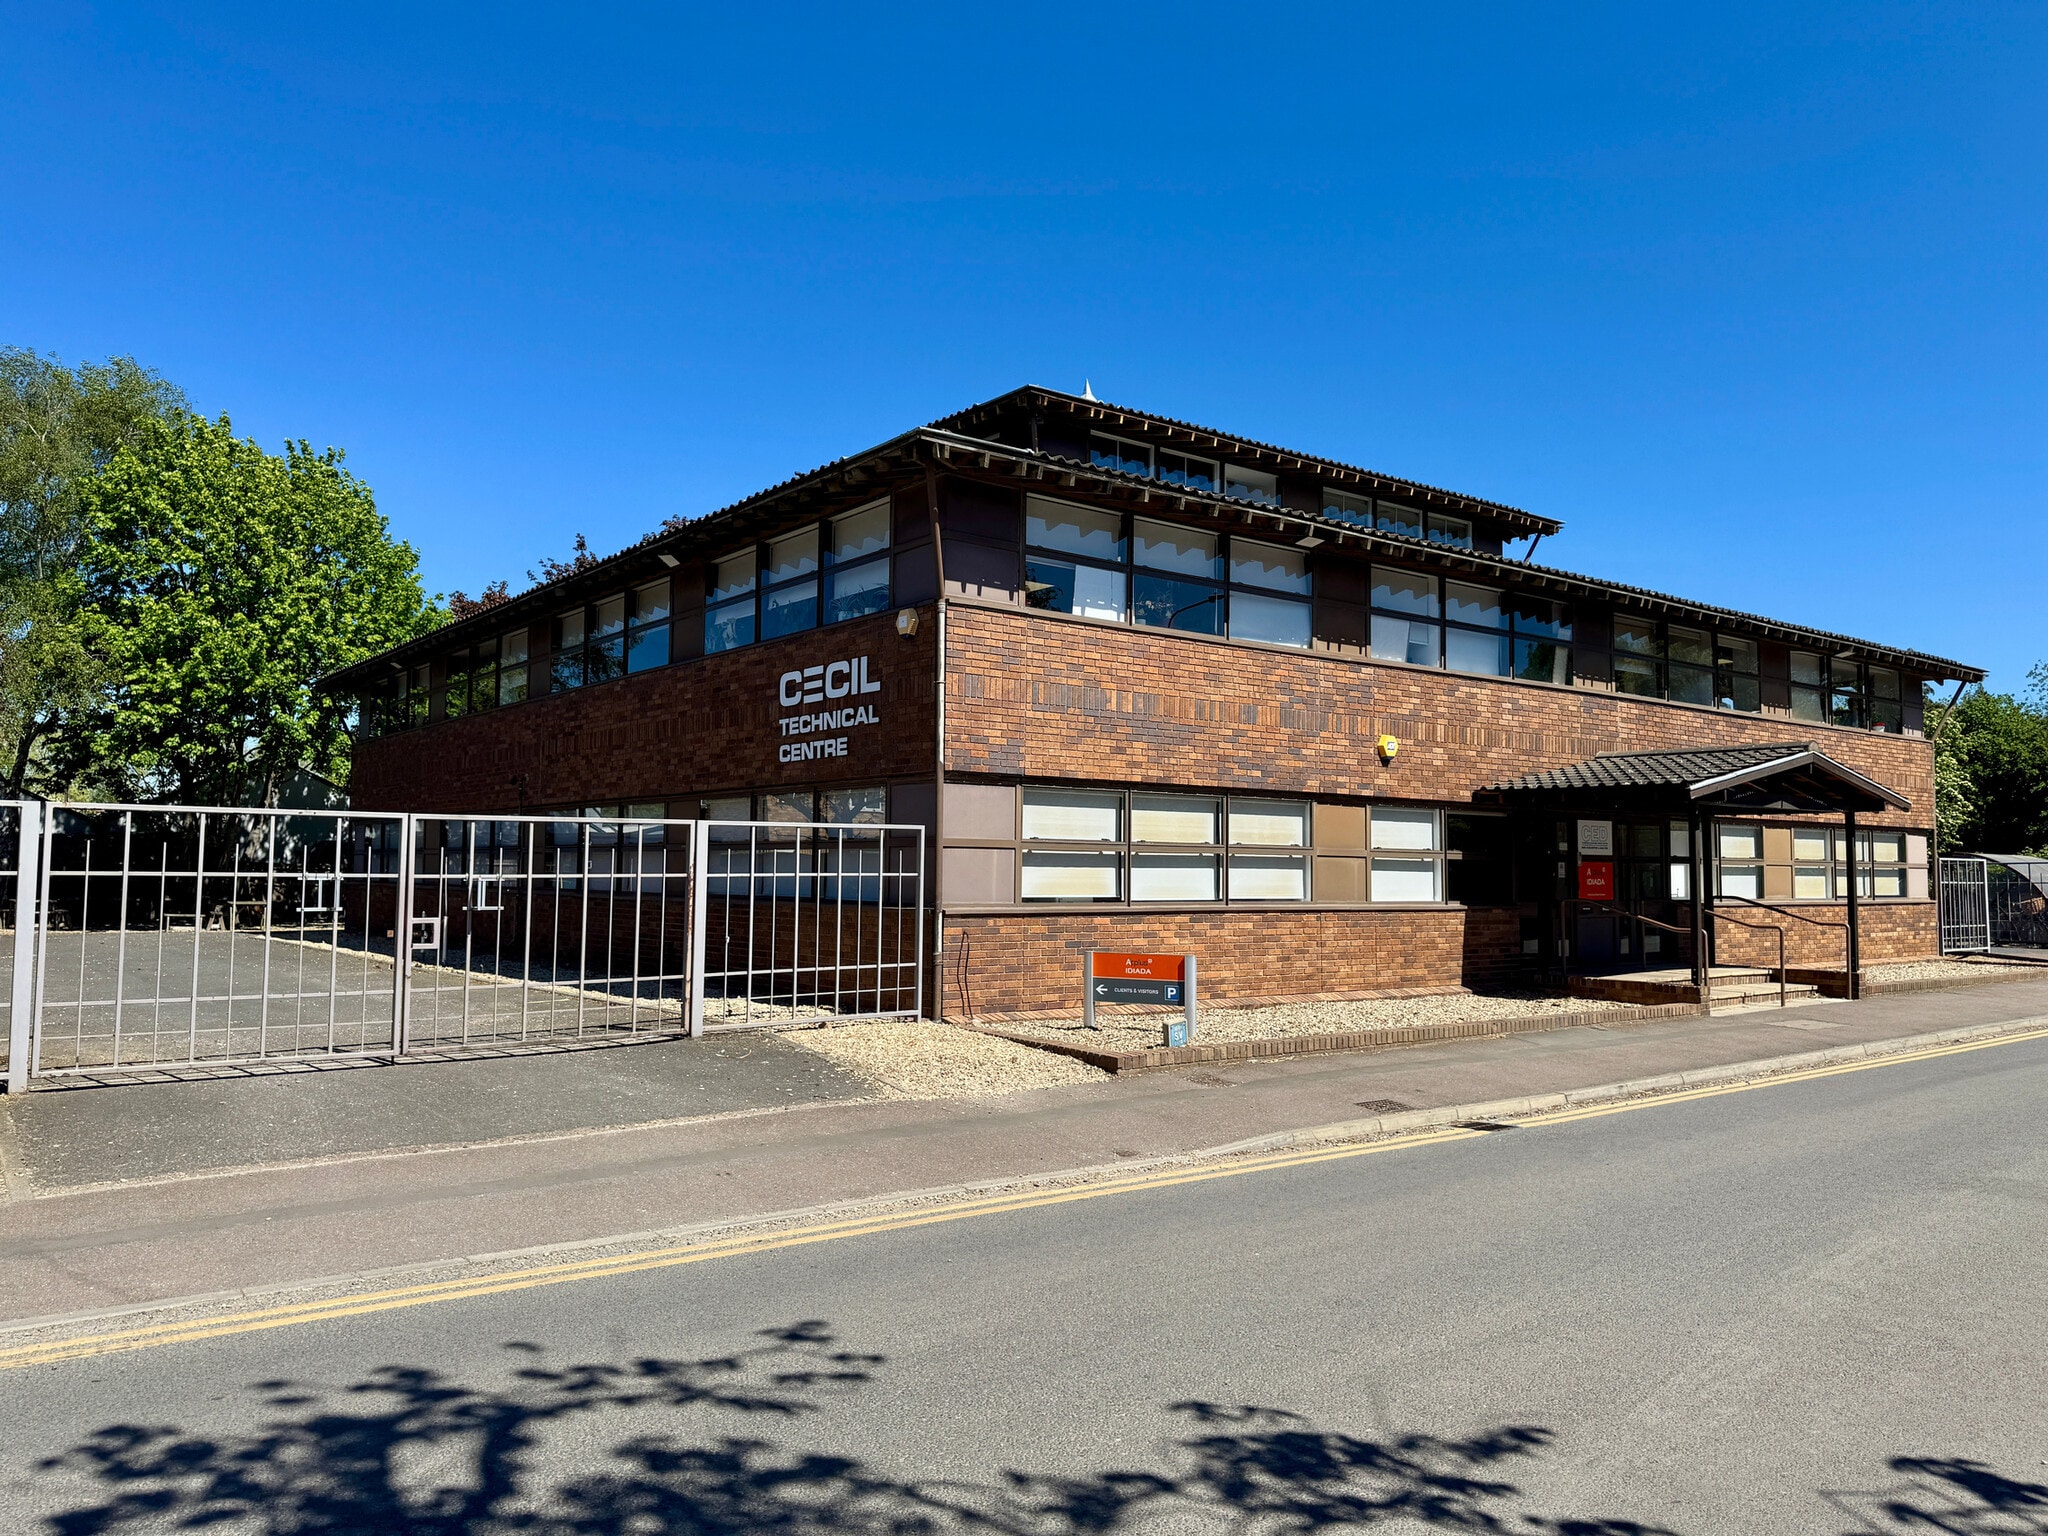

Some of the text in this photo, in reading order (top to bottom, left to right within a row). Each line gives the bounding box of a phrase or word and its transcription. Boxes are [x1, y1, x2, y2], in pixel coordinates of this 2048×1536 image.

[779, 656, 881, 707] CECIL
[779, 704, 880, 736] TECHNICAL
[779, 737, 848, 763] CENTRE
[1581, 825, 1608, 842] CED
[1167, 987, 1177, 999] P
